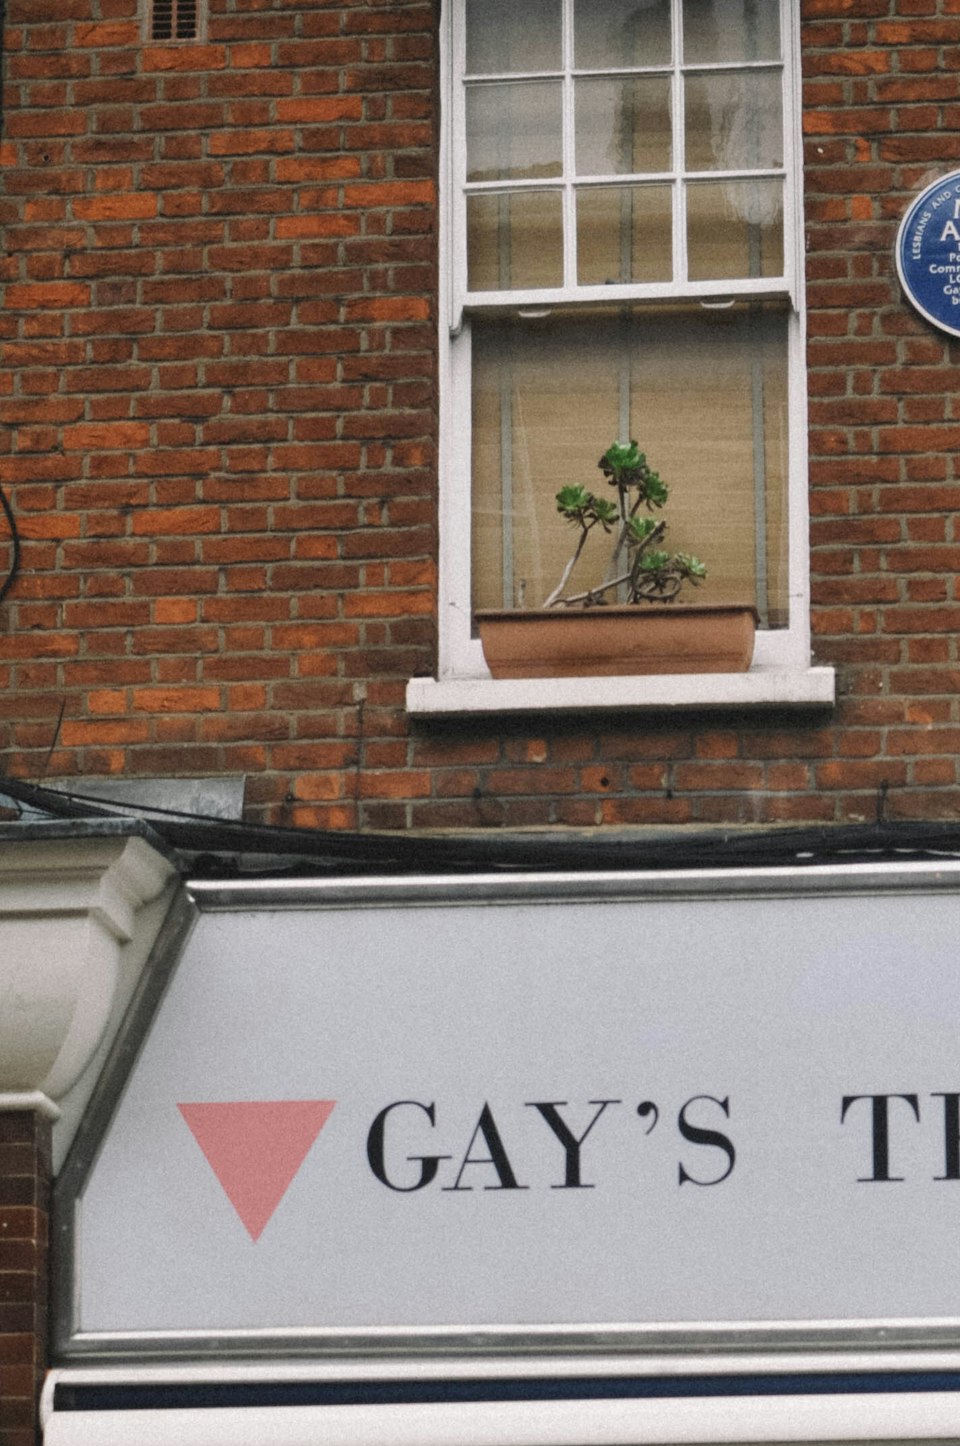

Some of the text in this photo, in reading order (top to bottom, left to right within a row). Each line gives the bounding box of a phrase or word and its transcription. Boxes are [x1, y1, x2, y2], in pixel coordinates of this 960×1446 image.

[912, 212, 932, 260] LESBIANS
[931, 191, 952, 210] AND
[366, 1095, 737, 1193] GAY'S
